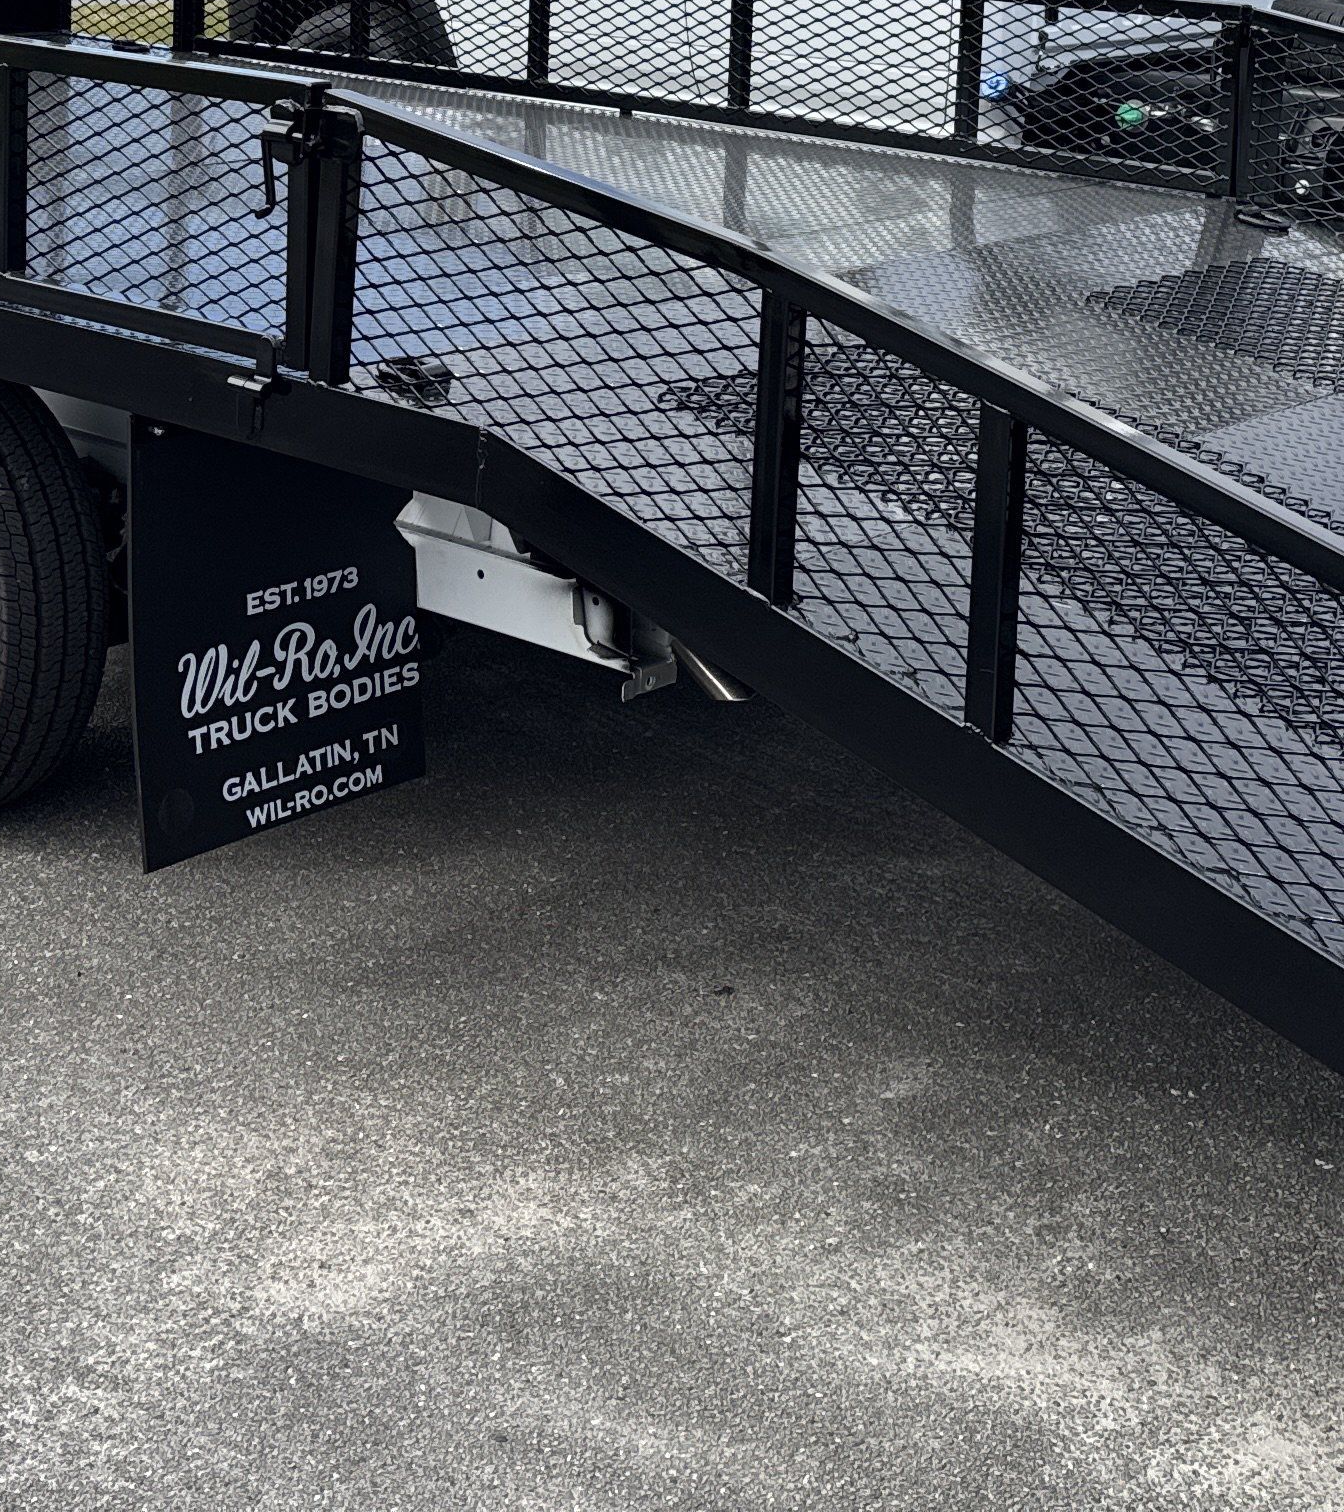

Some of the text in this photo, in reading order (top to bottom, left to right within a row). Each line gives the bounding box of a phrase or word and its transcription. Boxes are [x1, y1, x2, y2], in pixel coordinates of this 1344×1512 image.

[247, 566, 359, 616] EST. 1973
[178, 621, 340, 719] Wil-Ro,
[188, 662, 420, 755] TRUCK BODIES
[222, 724, 399, 802] GALLATIN, TN
[246, 765, 383, 828] WIL-RO.COM
